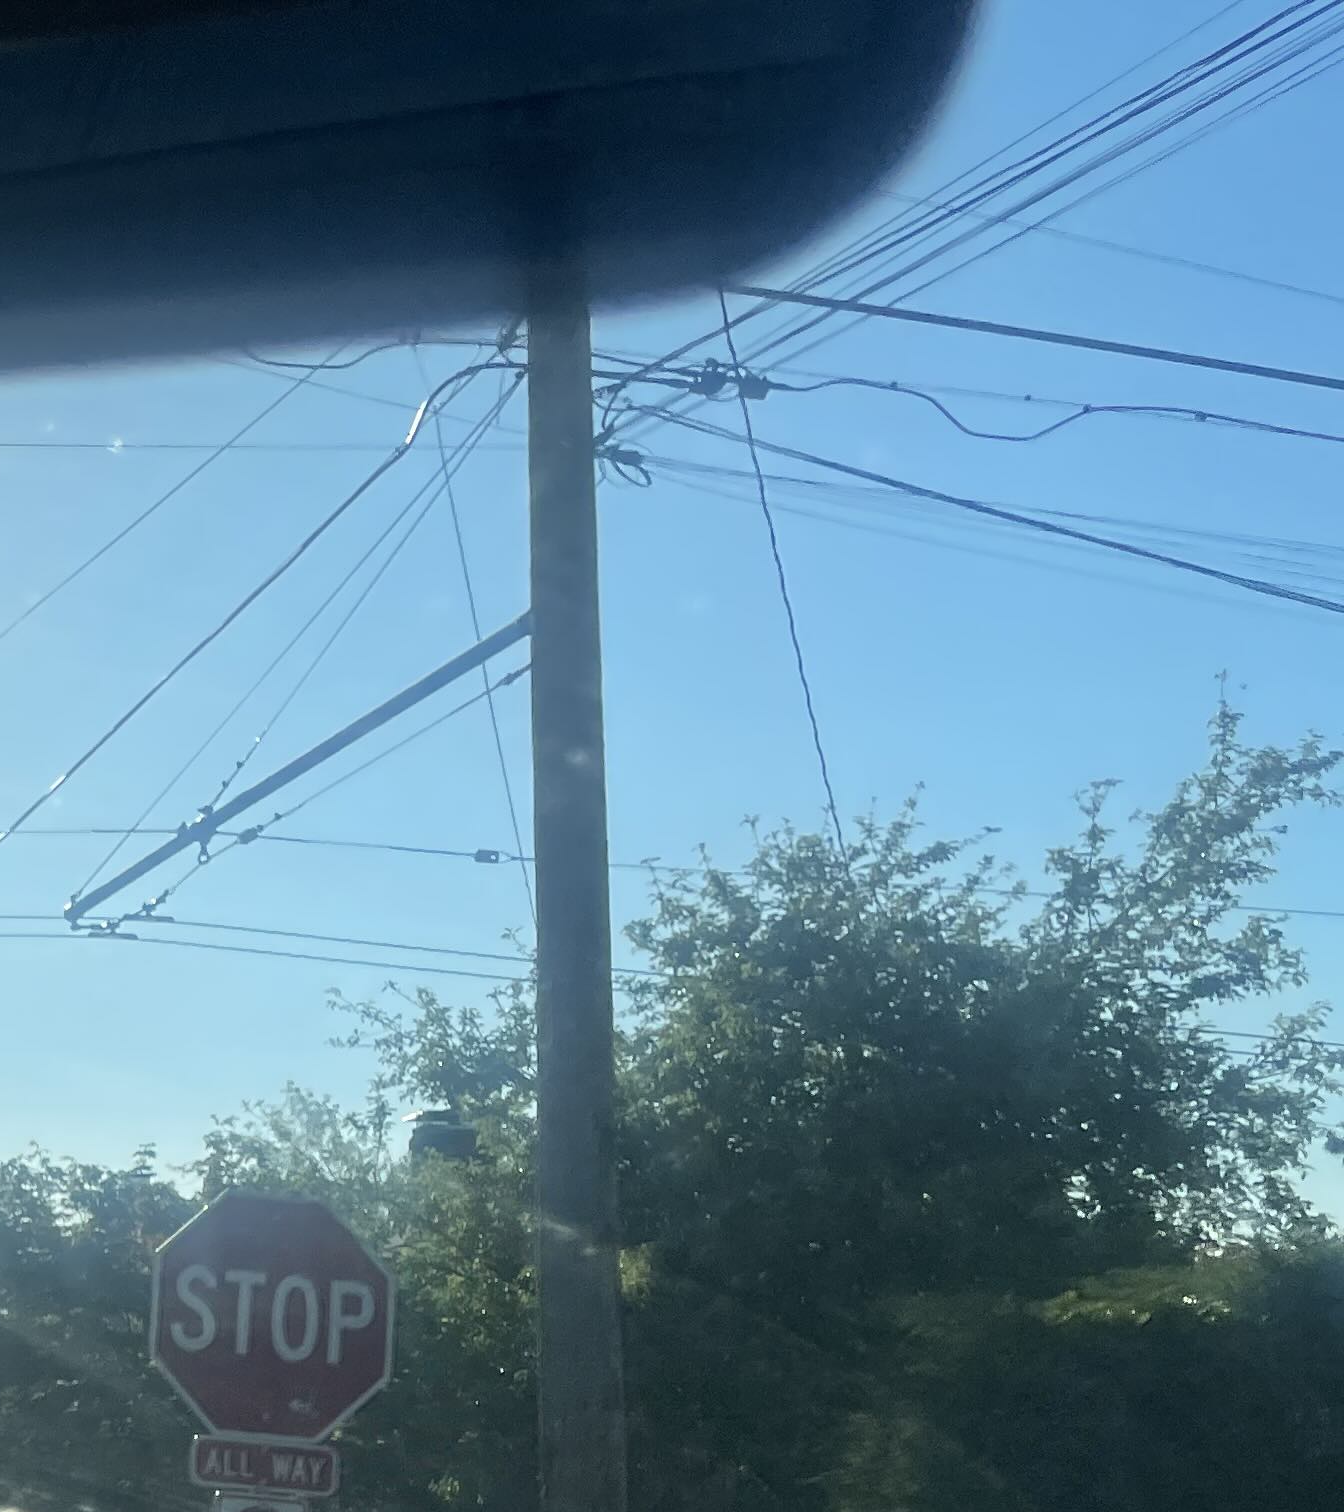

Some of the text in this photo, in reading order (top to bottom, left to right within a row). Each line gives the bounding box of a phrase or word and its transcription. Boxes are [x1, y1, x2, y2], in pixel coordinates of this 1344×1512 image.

[170, 1264, 376, 1364] STOP
[201, 1447, 327, 1485] ALL WAY
